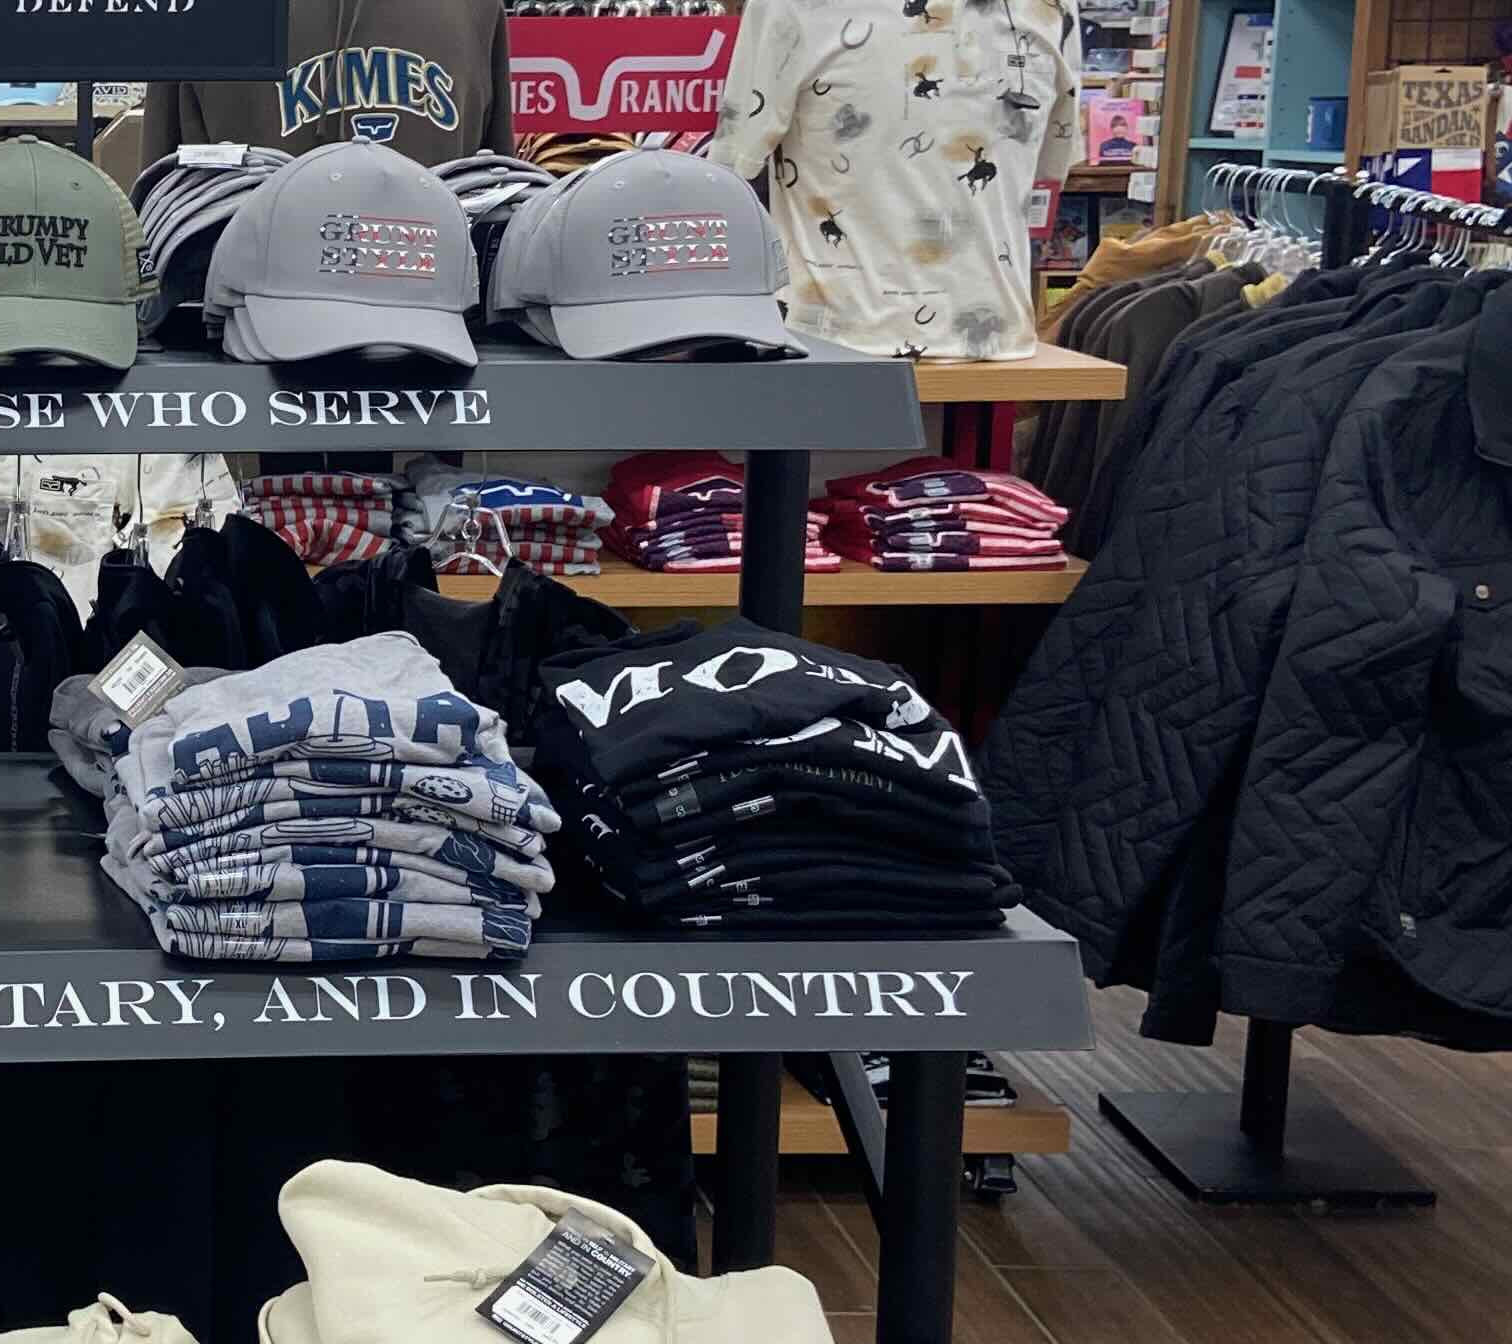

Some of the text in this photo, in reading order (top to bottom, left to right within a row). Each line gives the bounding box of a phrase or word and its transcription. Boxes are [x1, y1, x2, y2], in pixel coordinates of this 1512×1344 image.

[275, 47, 460, 137] KIMES
[1402, 81, 1482, 108] TEXAS
[319, 222, 438, 247] GRUNT
[608, 220, 728, 245] GRUNT
[321, 247, 435, 272] STYLE
[612, 243, 728, 269] STYLE
[82, 390, 247, 428] WHO
[268, 389, 491, 426] SERVE
[252, 975, 427, 1023] AND
[452, 973, 543, 1019] IN
[568, 971, 974, 1018] COUNTRY
[561, 1231, 581, 1246] AND
[590, 1249, 634, 1279] COUNTRY
